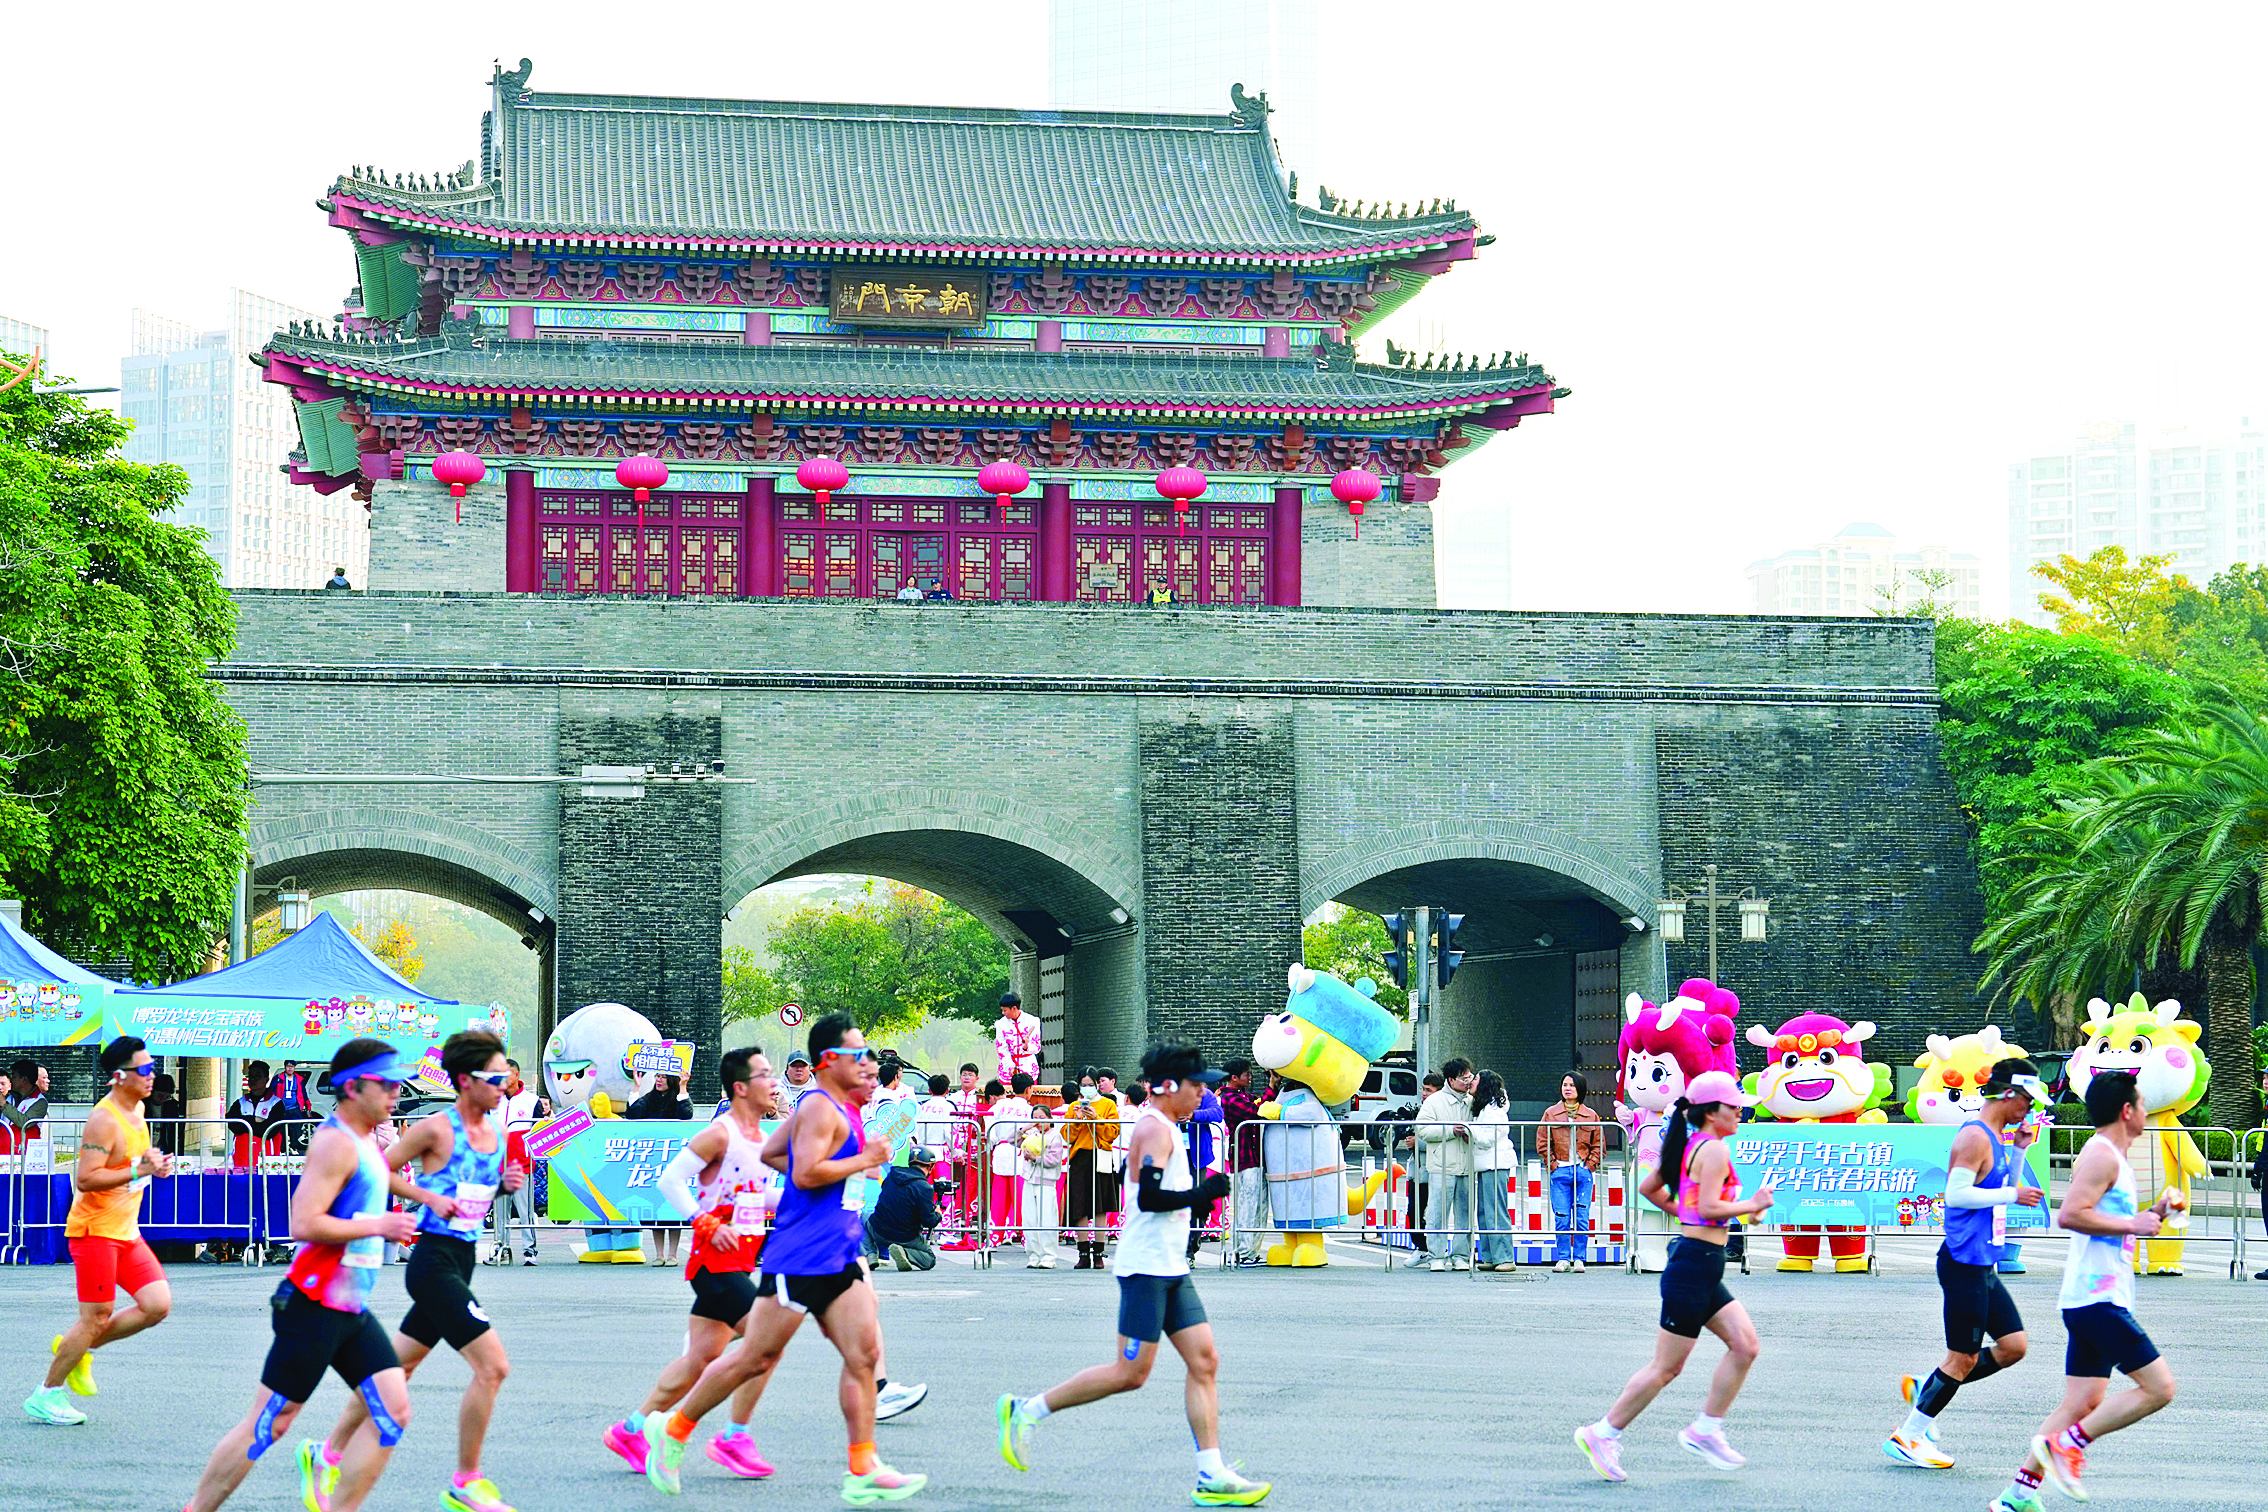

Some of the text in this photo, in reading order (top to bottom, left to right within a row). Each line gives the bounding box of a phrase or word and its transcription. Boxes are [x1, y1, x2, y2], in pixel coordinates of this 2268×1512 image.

[131, 1006, 266, 1027] 博罗龙华龙宝家族
[633, 1053, 683, 1072] 相信自己
[1734, 1140, 1894, 1166] 罗浮千年古镇
[1759, 1166, 1918, 1192] 龙华待君来游
[1801, 1198, 1825, 1207] 2025
